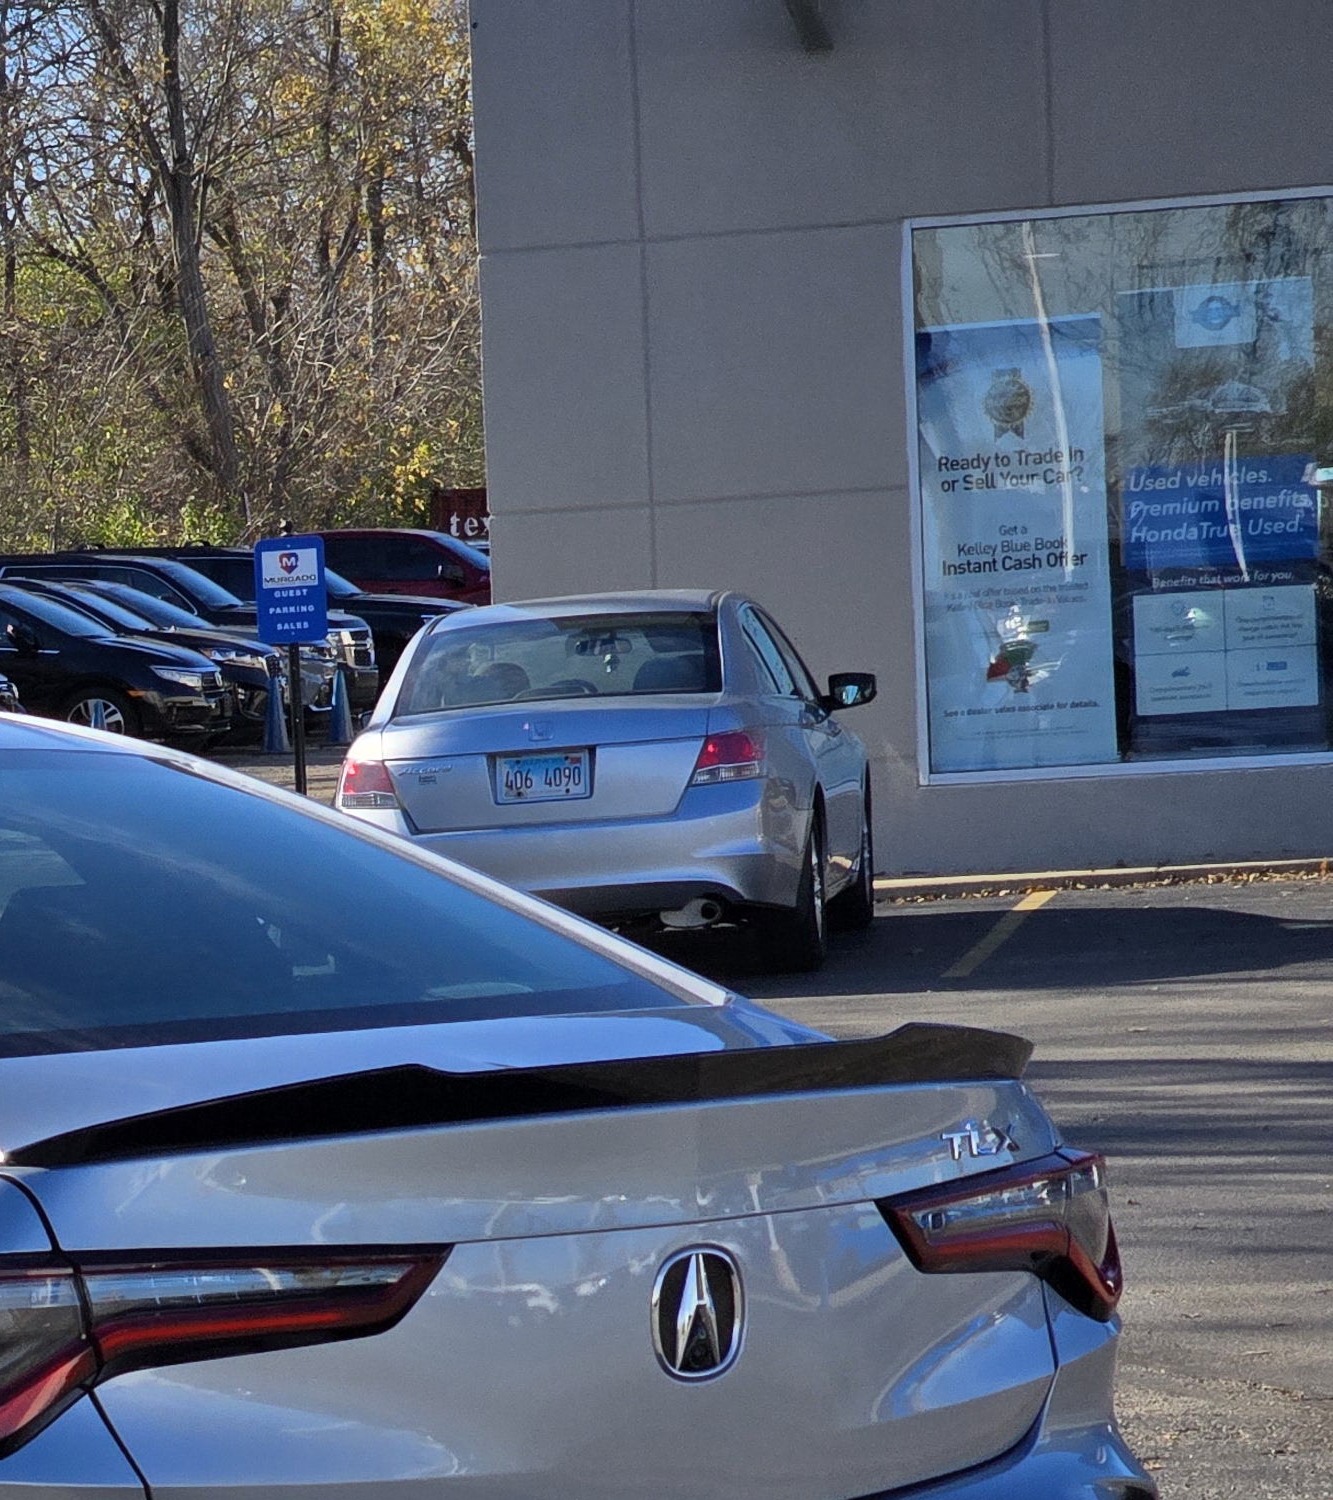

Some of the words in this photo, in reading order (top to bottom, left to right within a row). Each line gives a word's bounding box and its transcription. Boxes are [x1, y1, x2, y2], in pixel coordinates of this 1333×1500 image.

[938, 453, 991, 472] Ready
[995, 453, 1010, 467] to
[941, 478, 959, 492] or
[962, 473, 996, 490] Sell
[999, 470, 1039, 487] Your
[1043, 465, 1084, 485] Car?
[1130, 470, 1181, 492] Used
[1186, 466, 1273, 487] vehcles.
[1129, 498, 1219, 519] Premium
[998, 525, 1018, 536] Get
[1020, 525, 1028, 535] a
[1248, 514, 1304, 535] Used.
[957, 543, 997, 557] Kelley
[1001, 540, 1031, 553] Blue
[1035, 536, 1068, 550] Book
[942, 558, 998, 576] Instant
[1001, 554, 1042, 572] Cash
[1254, 569, 1269, 581] for
[264, 574, 316, 583] MURGADO
[274, 589, 308, 598] GUEST
[269, 604, 315, 614] PARKING
[277, 621, 309, 630] SALES
[505, 768, 533, 790] 406
[544, 766, 581, 788] 4090
